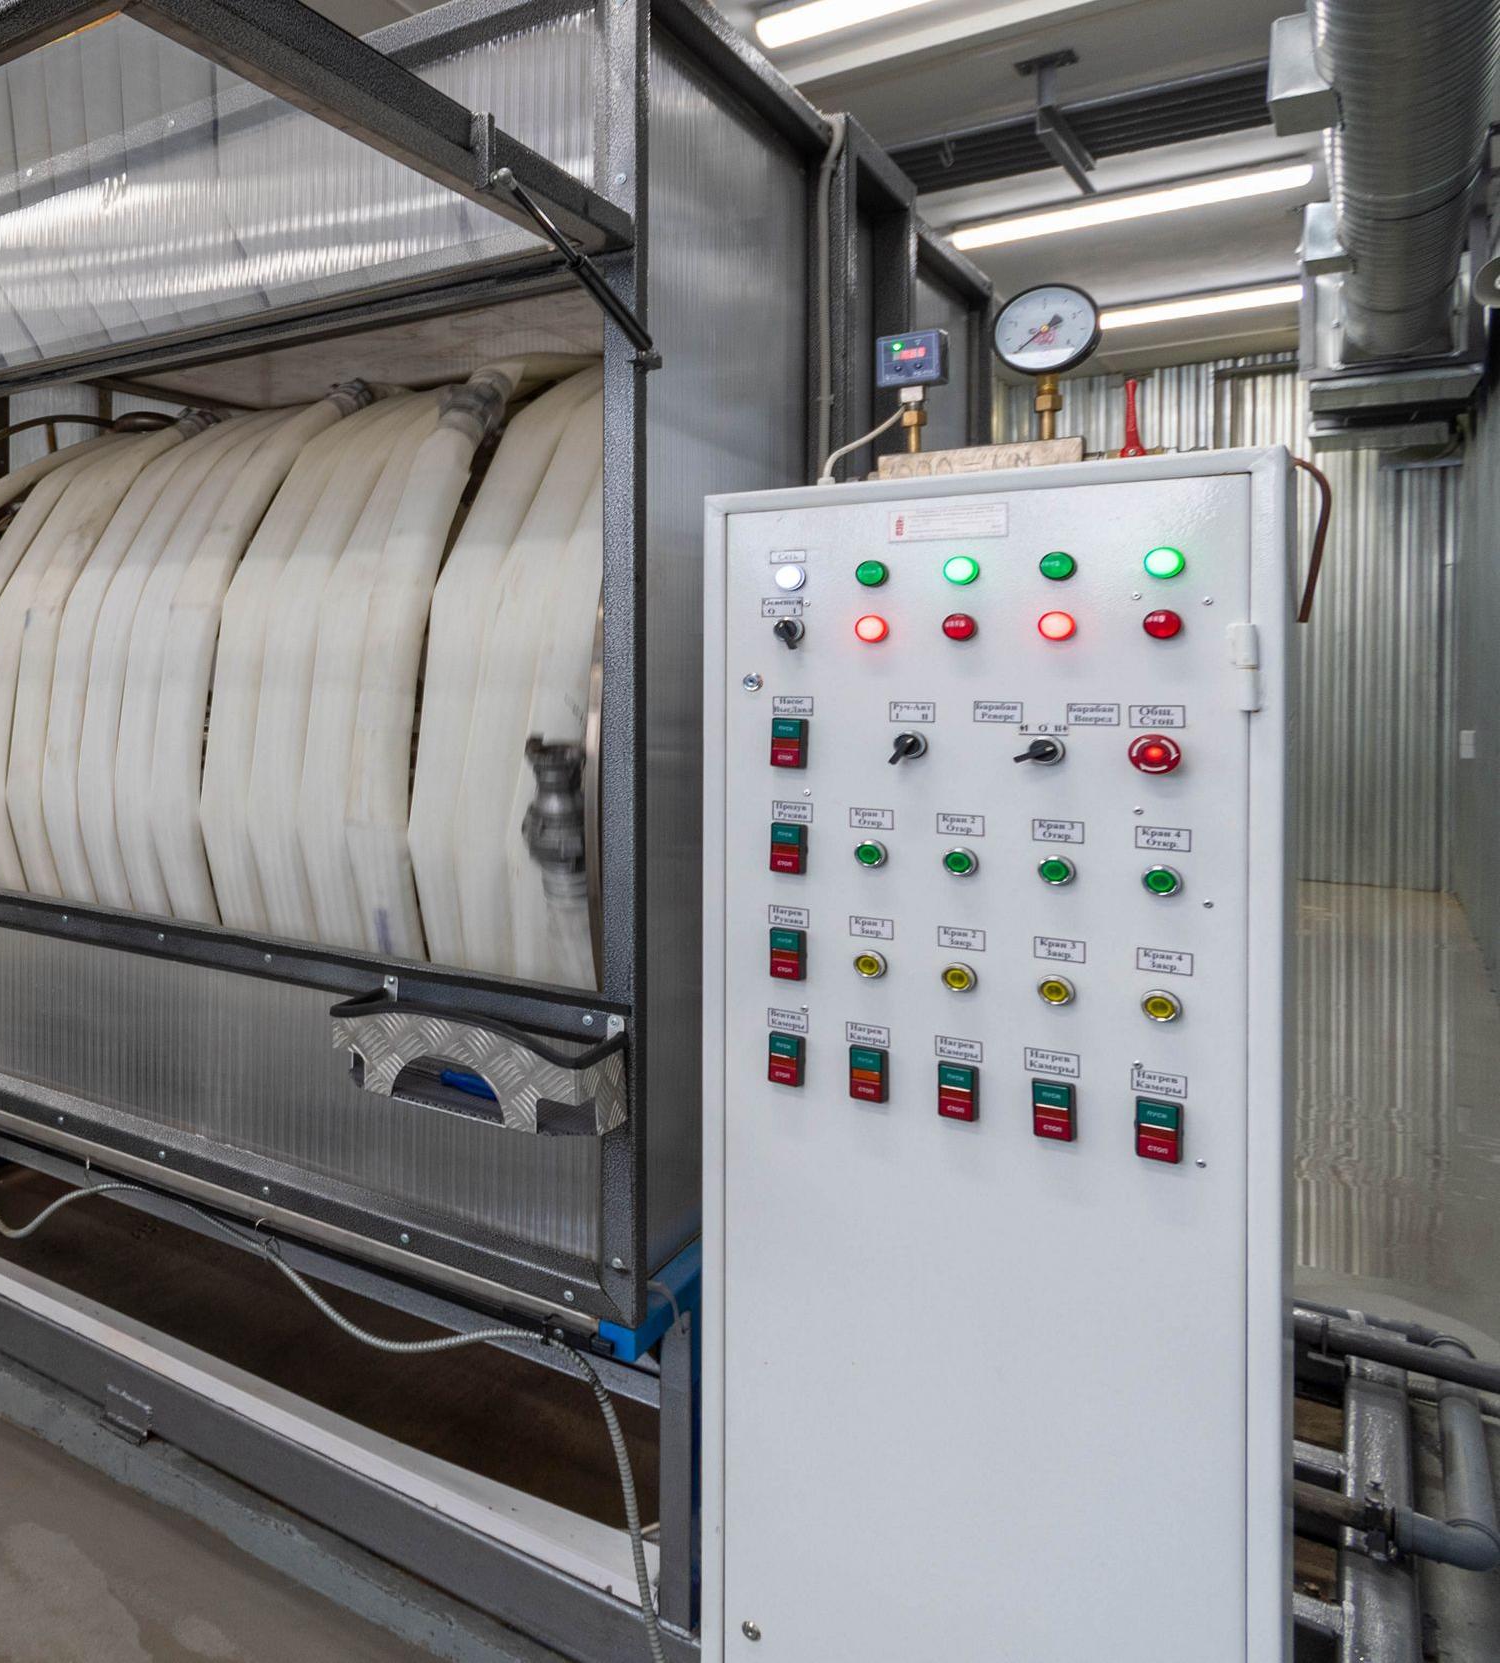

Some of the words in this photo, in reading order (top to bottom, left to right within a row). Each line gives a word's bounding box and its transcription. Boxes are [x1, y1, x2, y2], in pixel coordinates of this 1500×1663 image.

[975, 702, 1018, 712] Барабан
[1069, 705, 1114, 715] Барабан
[981, 713, 1015, 722] Реверс
[1140, 716, 1174, 725] Стоп
[855, 810, 878, 818] Кран
[942, 815, 967, 824] Кран
[1038, 821, 1065, 830] Кран
[1142, 828, 1171, 838] Кран
[773, 906, 802, 916] Нагрев
[854, 917, 878, 926] Кран
[943, 927, 968, 937] Кран
[1040, 938, 1067, 949] Кран
[1143, 950, 1172, 961] Кран
[771, 1019, 805, 1031] Камеры
[850, 1024, 883, 1035] Нагрев
[850, 1033, 886, 1044] Камеры
[940, 1038, 975, 1049] Нагрев
[939, 1047, 978, 1059] Камеры
[1030, 1050, 1070, 1062] Нагрев
[1029, 1060, 1075, 1074] Камеры
[1137, 1071, 1178, 1084] Нагрев
[1136, 1080, 1182, 1095] Камеры
